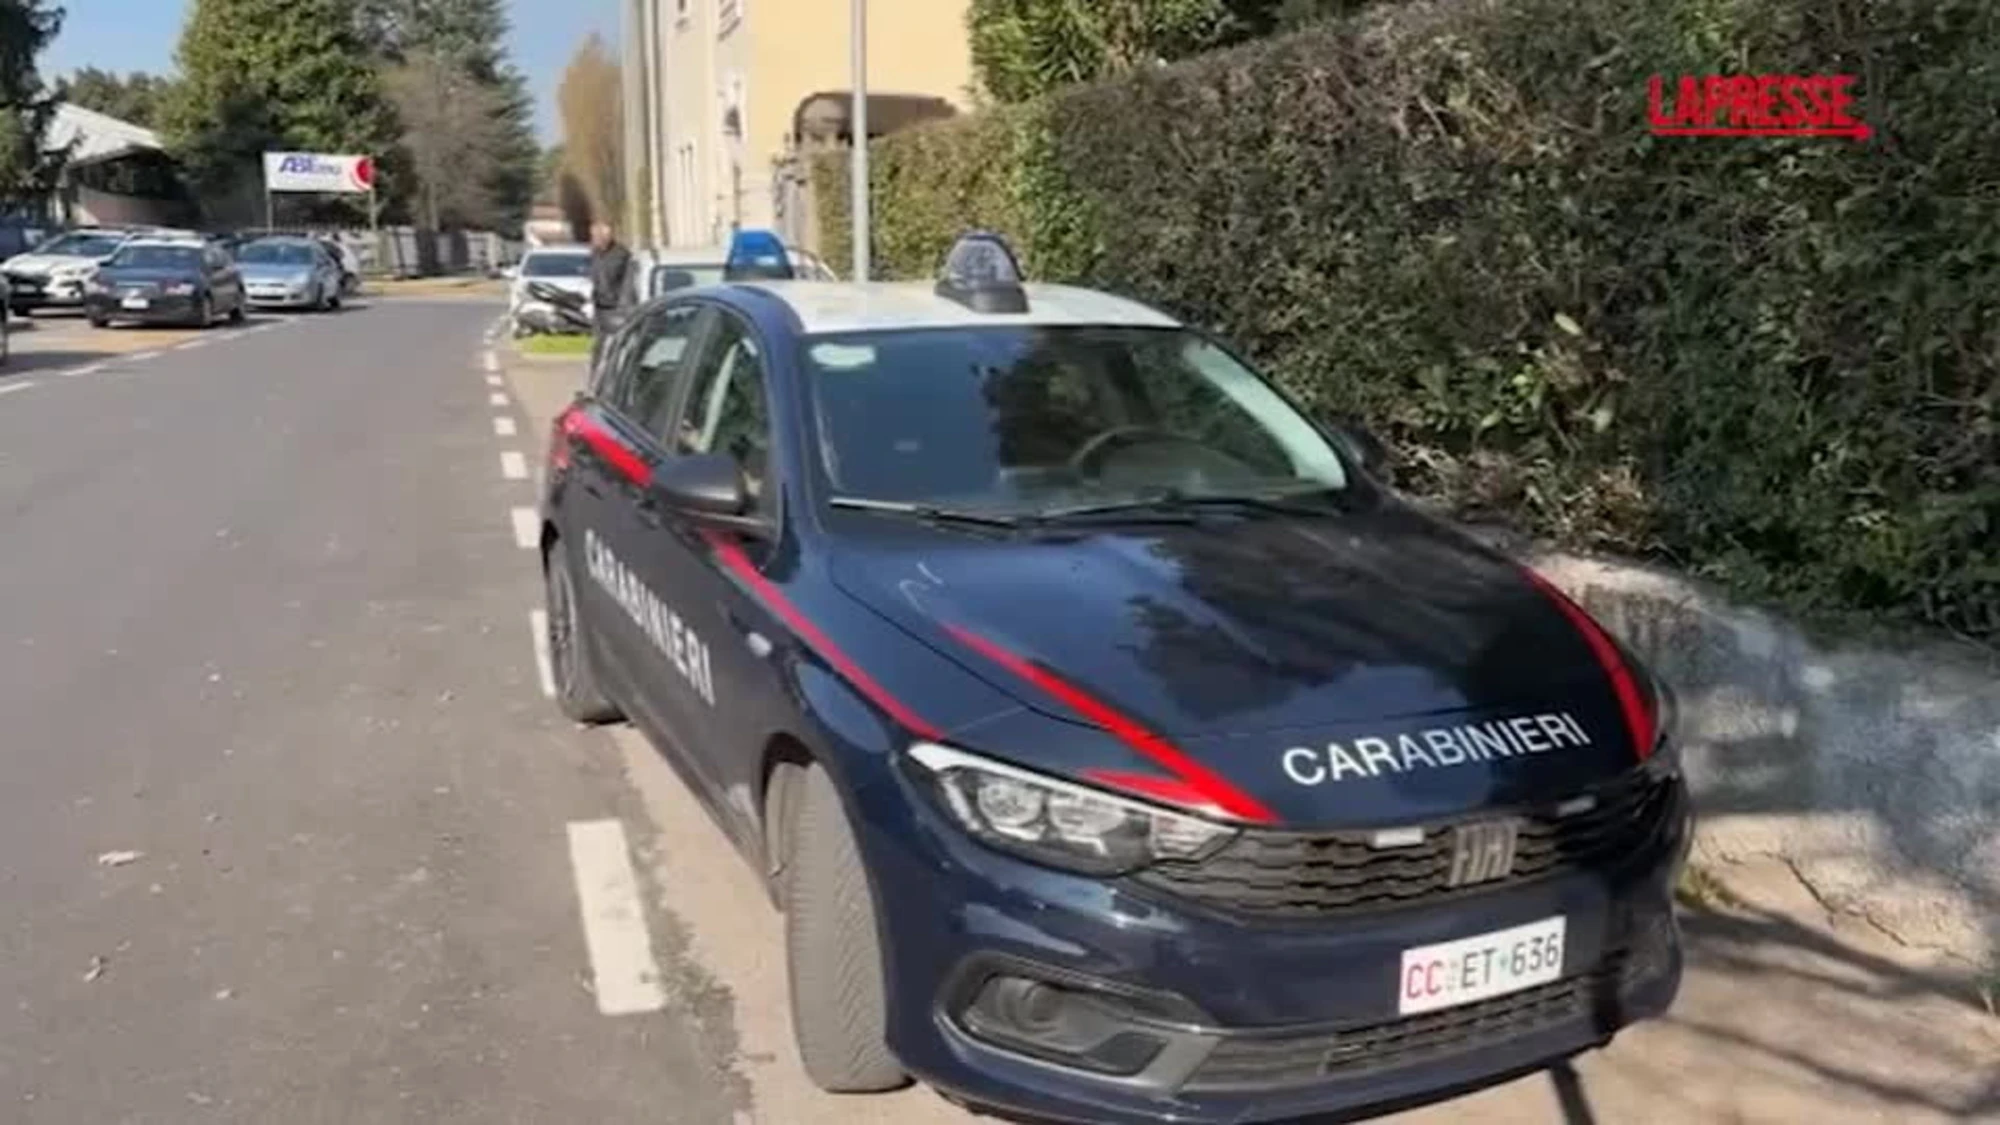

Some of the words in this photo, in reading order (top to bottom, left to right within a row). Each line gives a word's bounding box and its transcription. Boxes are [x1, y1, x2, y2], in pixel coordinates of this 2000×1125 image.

[585, 528, 715, 706] CARABINIERI
[1282, 712, 1592, 785] CARABINIERI
[1406, 960, 1443, 999] CC
[1461, 947, 1497, 988] ET
[1510, 932, 1560, 977] 636
